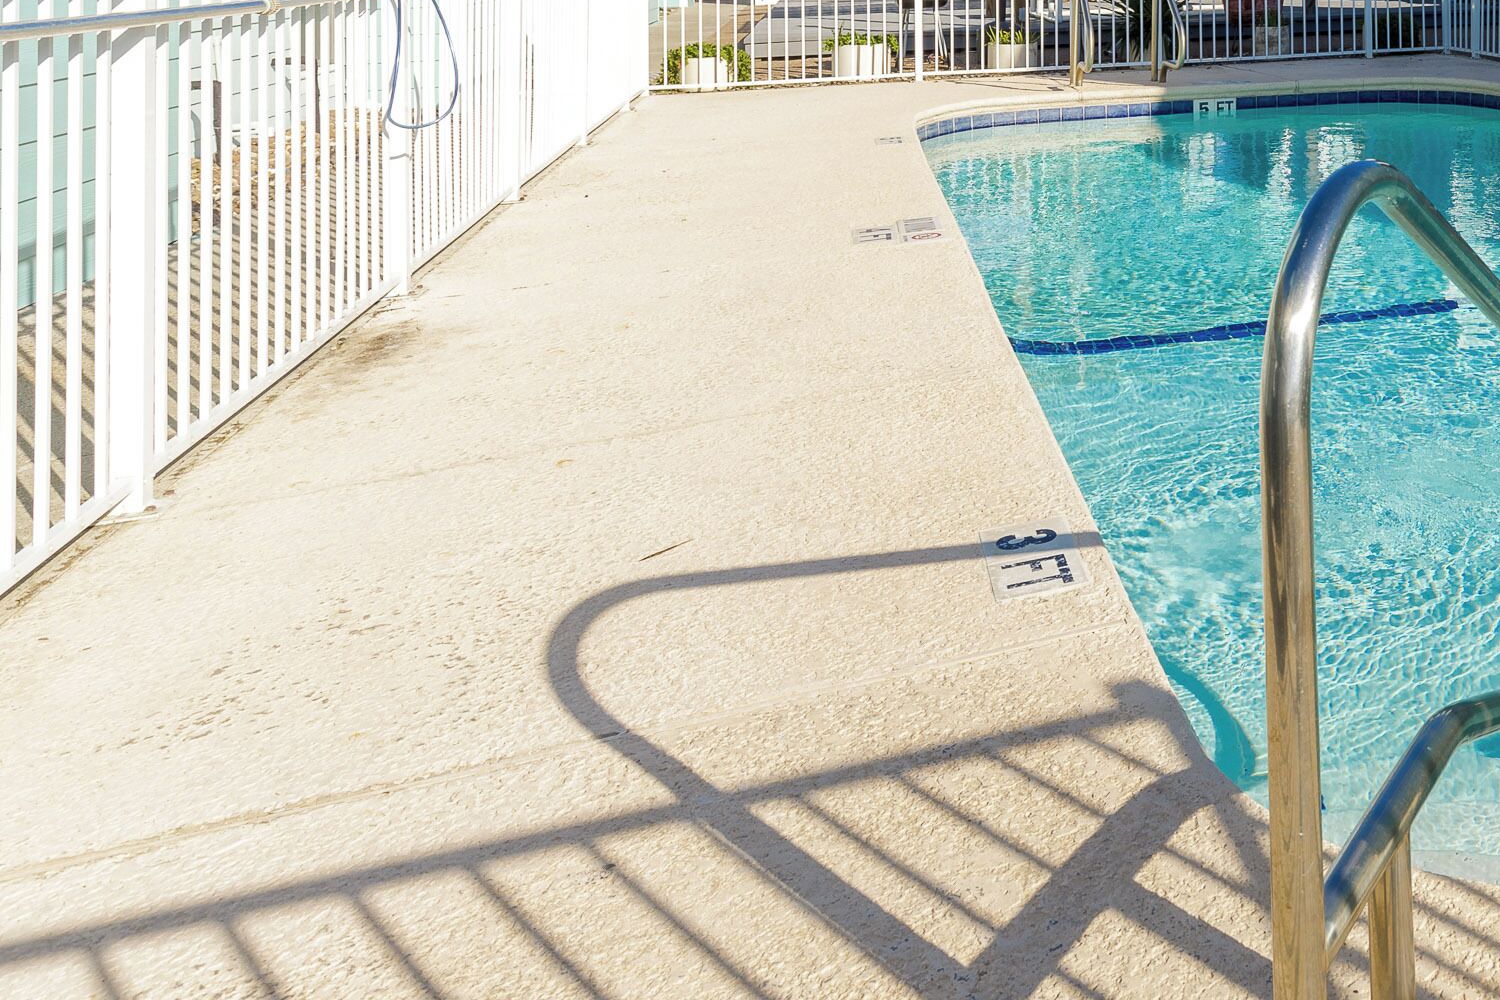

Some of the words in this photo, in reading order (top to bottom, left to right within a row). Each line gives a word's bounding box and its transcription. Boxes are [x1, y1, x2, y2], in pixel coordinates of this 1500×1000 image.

[1199, 102, 1209, 112] 5
[1216, 100, 1233, 112] FT
[995, 528, 1057, 550] 3
[1001, 553, 1074, 590] FT
